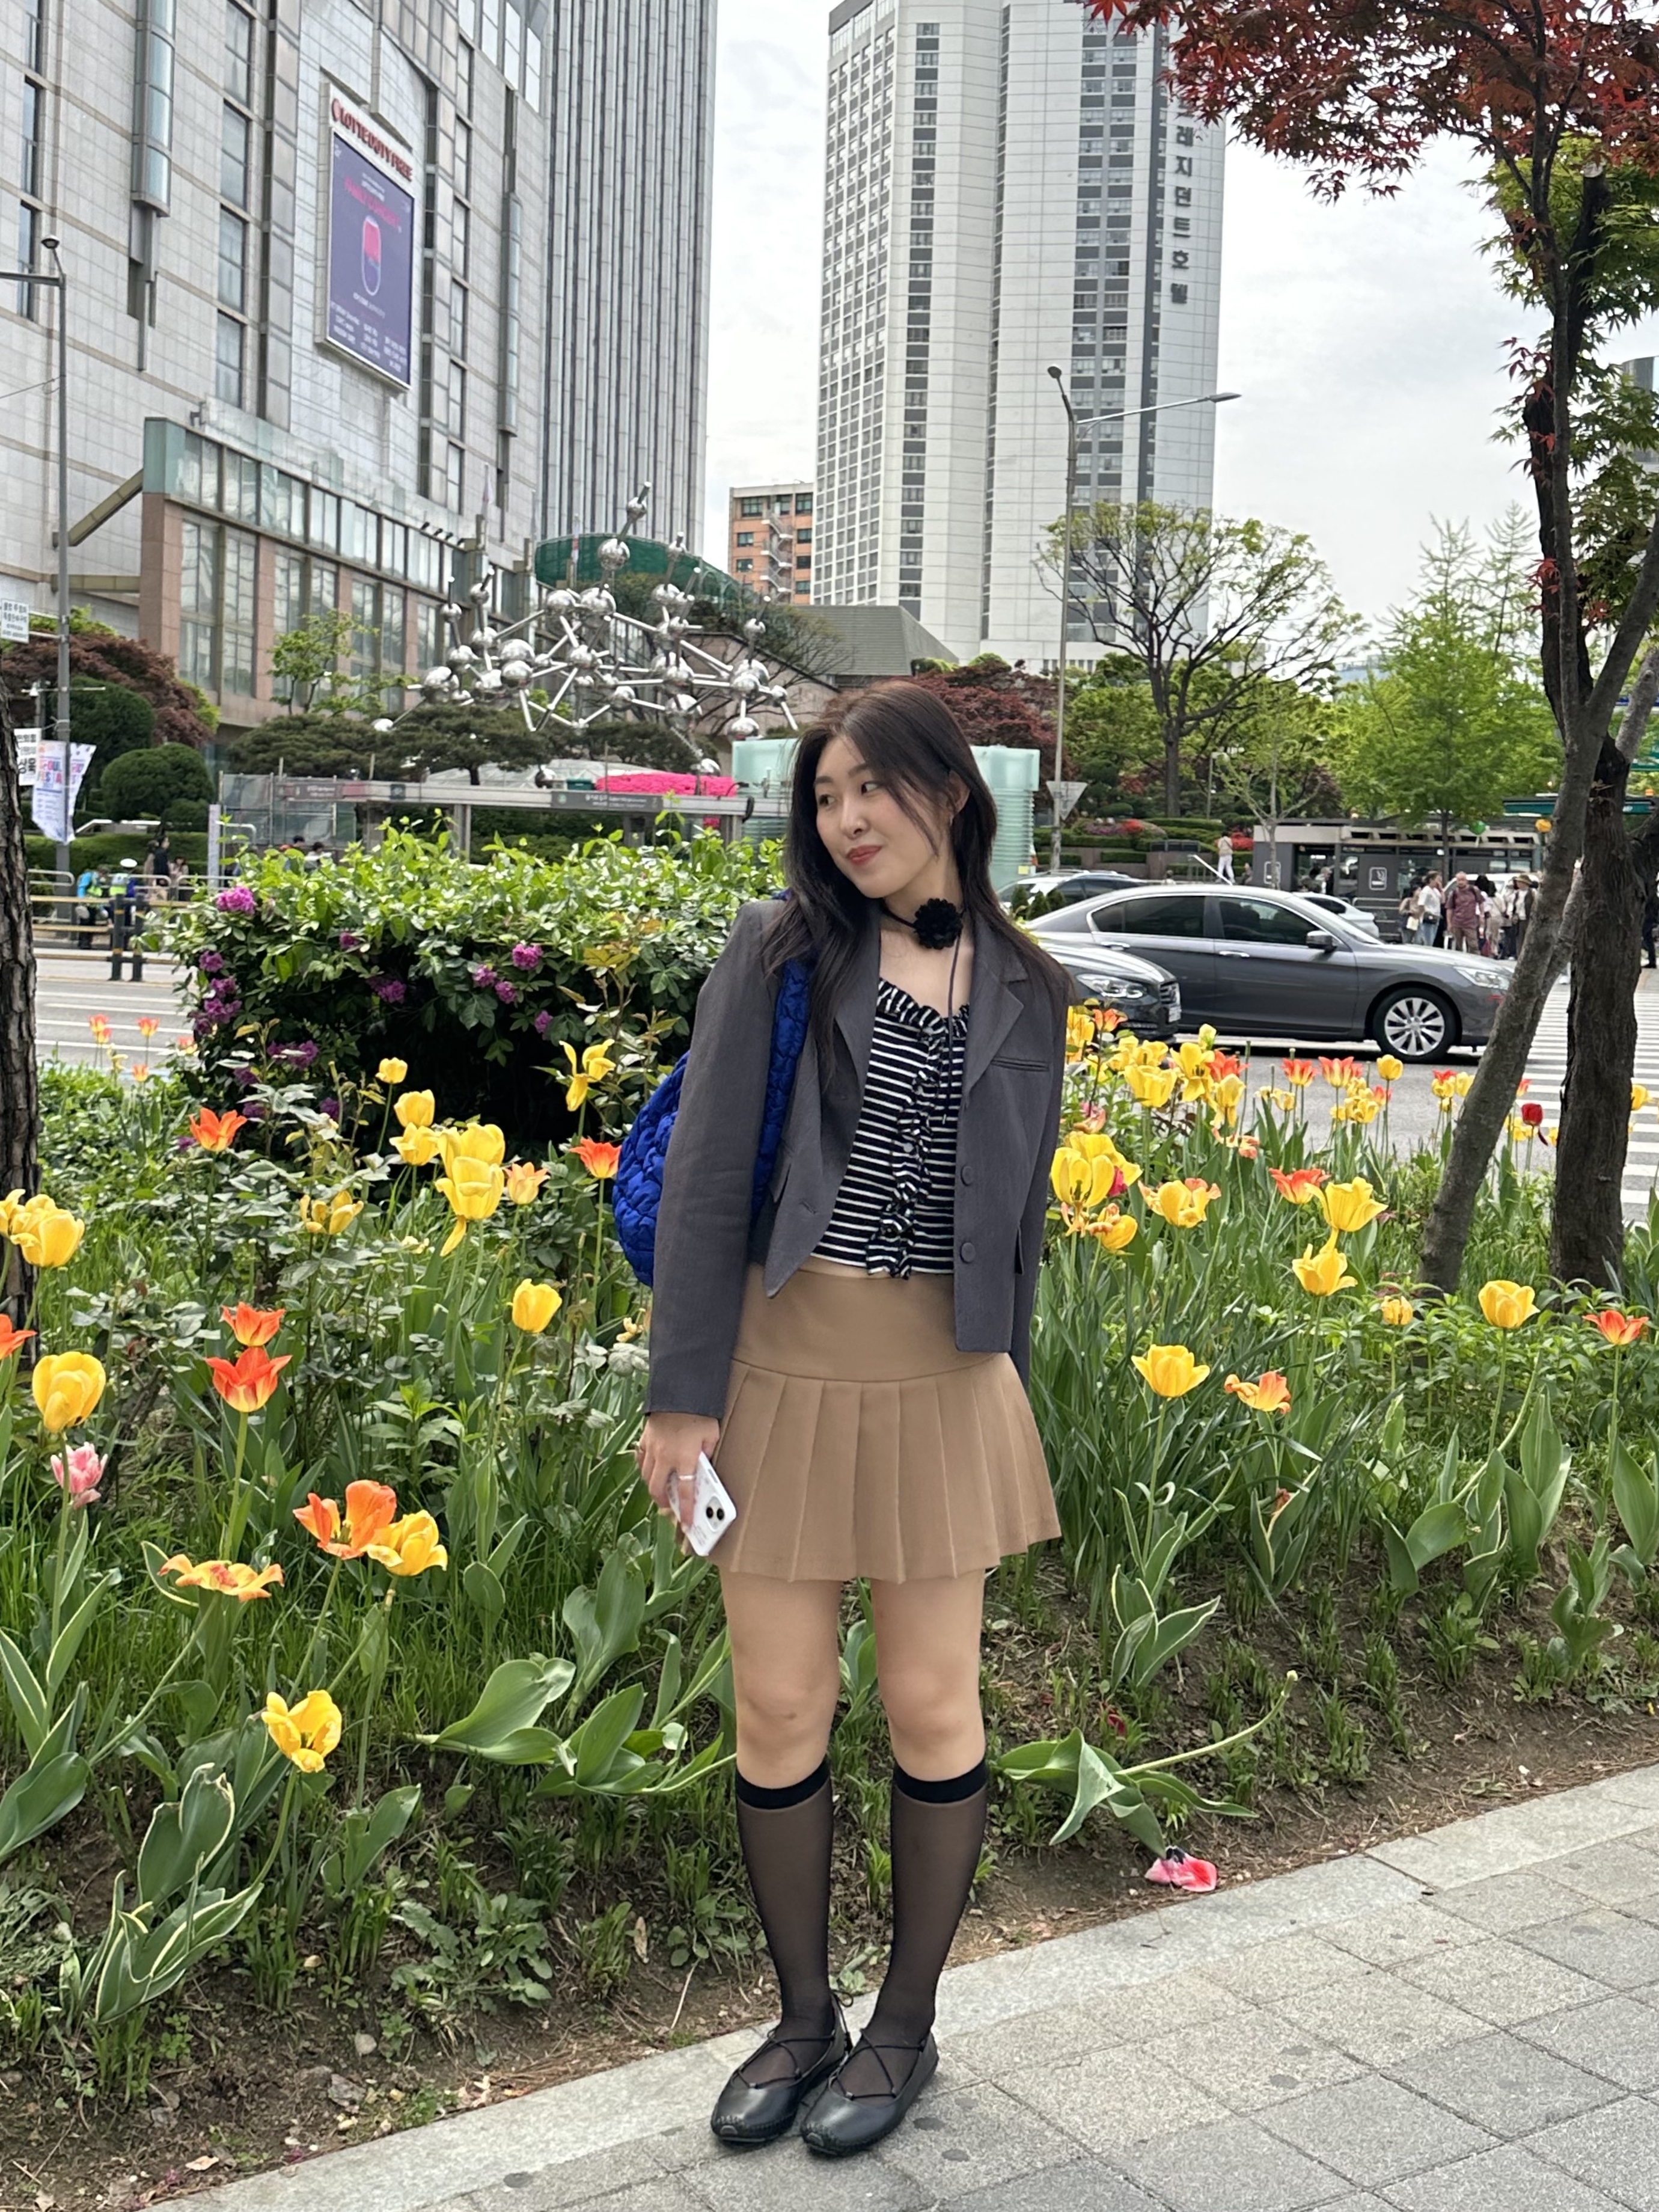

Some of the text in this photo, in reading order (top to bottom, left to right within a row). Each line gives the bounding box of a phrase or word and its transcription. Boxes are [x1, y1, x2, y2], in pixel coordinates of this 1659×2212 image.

[340, 107, 413, 182] LOTTE DUTY FREE
